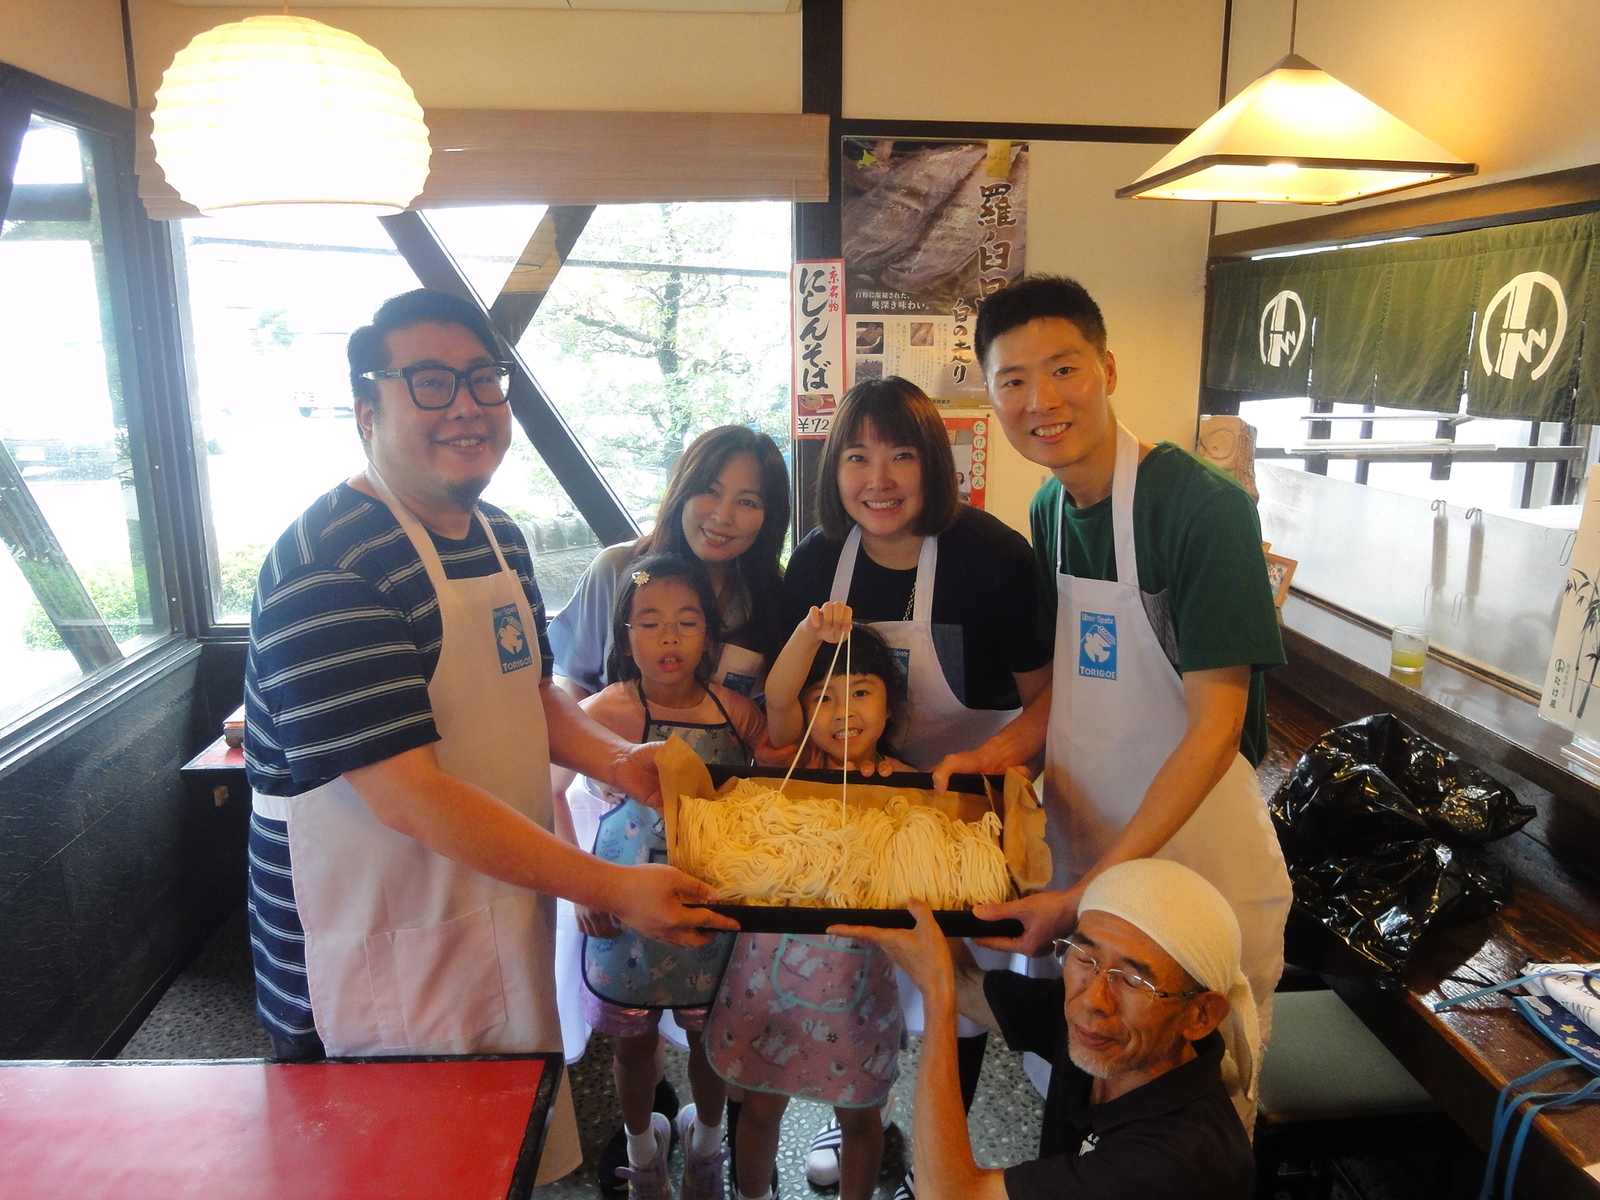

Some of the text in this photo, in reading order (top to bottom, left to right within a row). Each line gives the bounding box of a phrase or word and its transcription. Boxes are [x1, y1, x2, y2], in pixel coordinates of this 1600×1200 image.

[828, 266, 839, 312] 京名物
[871, 300, 930, 310] 奥深き味わい。
[799, 267, 832, 392] にしんそば
[973, 422, 985, 488] たけやさん
[1080, 666, 1116, 679] TORIGOE
